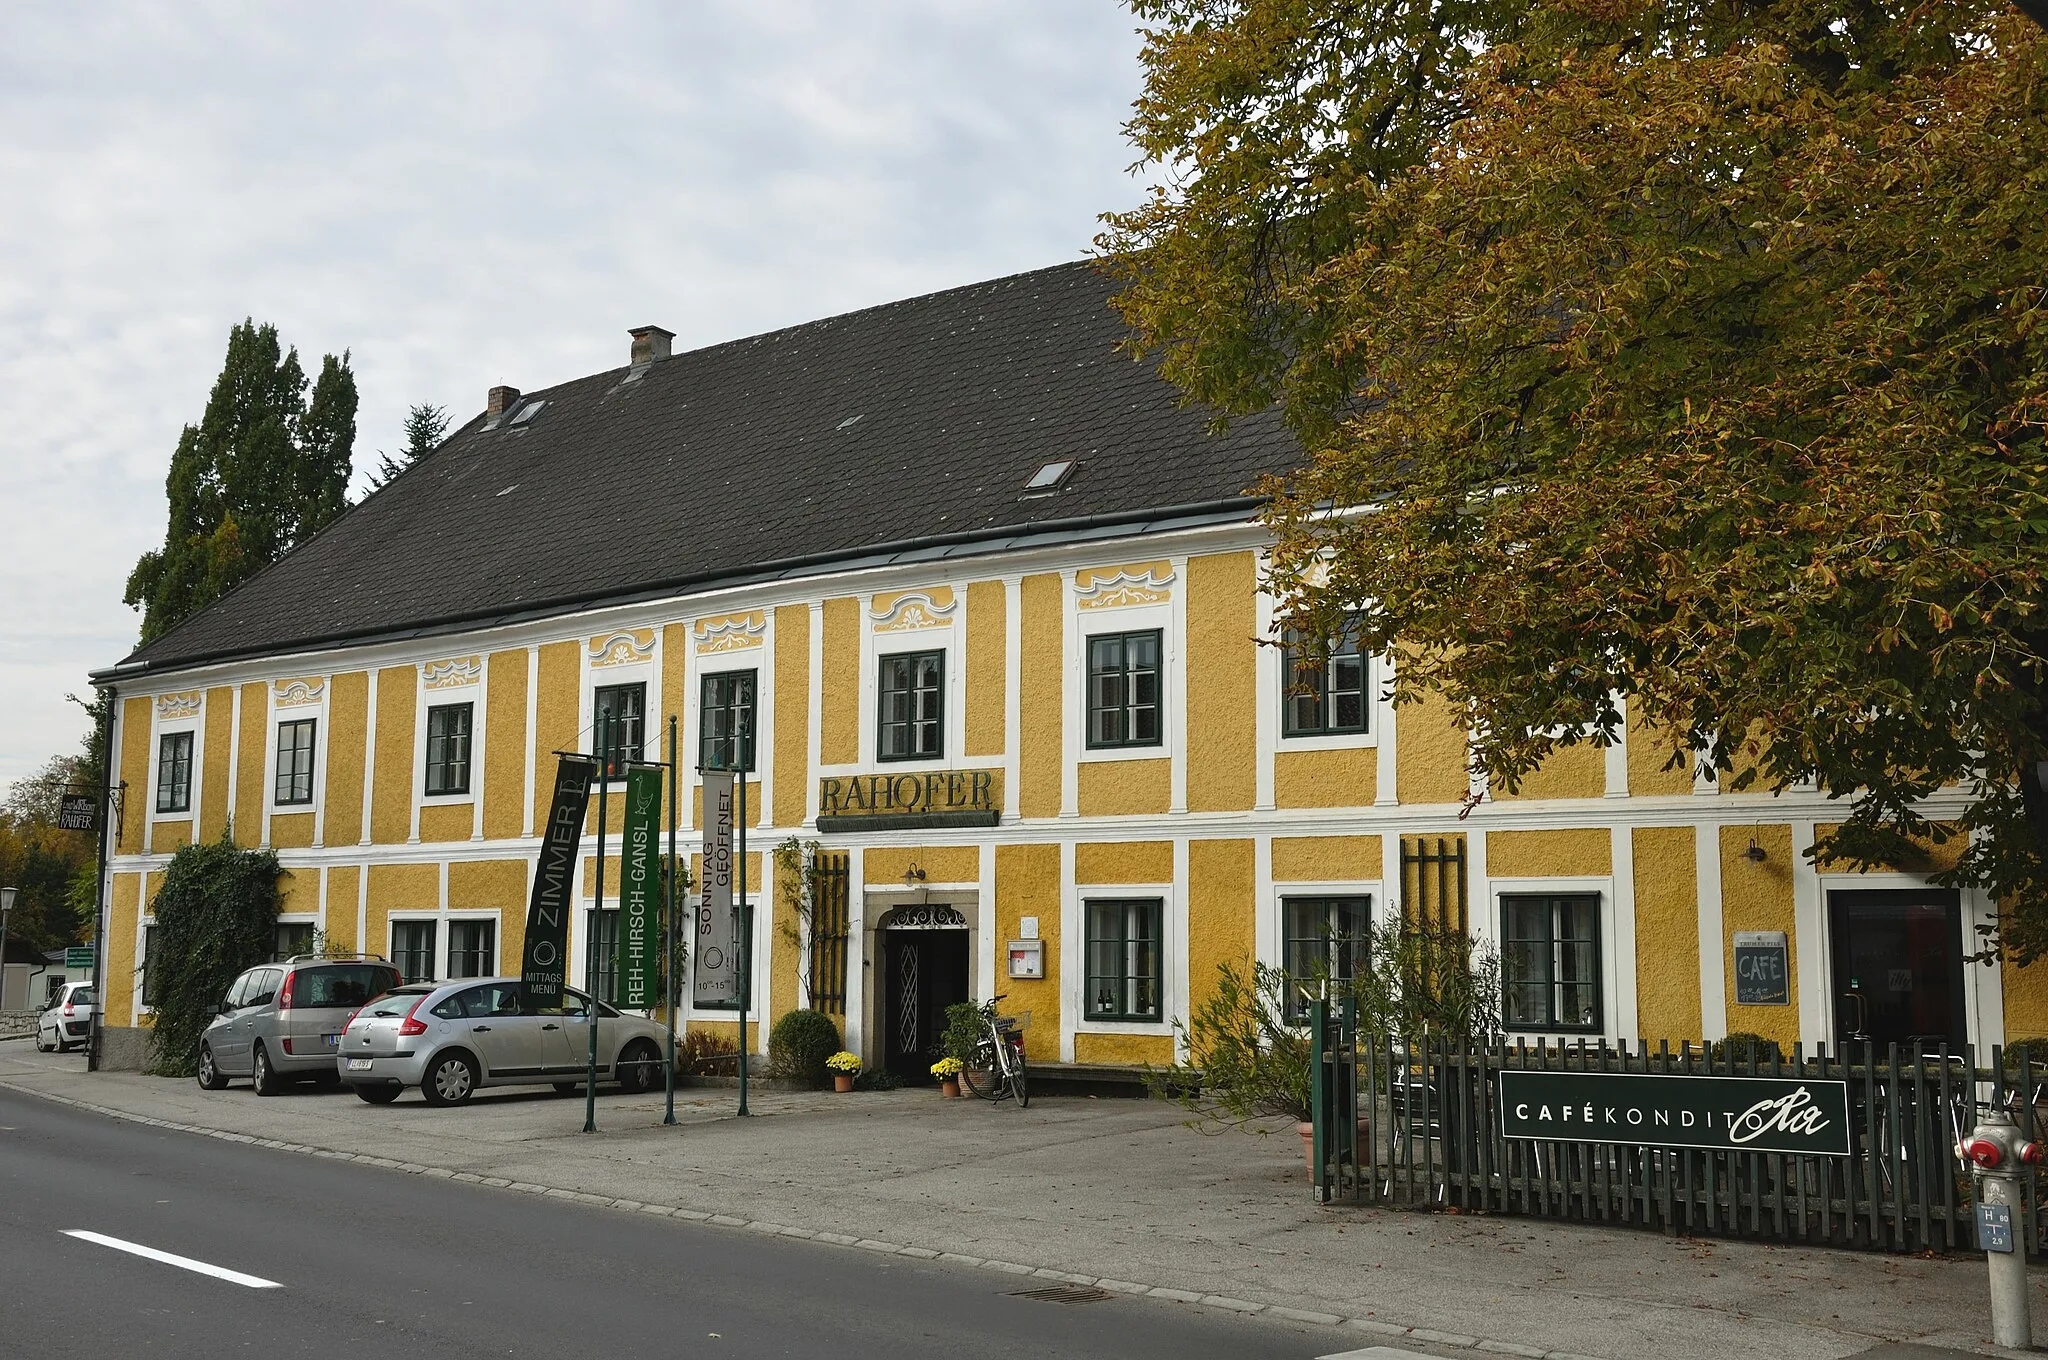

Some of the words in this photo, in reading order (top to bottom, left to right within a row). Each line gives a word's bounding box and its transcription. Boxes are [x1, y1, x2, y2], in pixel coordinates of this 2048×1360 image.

[820, 771, 992, 811] RAHOFER
[715, 790, 729, 887] GEÖFFNET
[537, 805, 577, 928] ZIMMER
[700, 842, 713, 935] SONNTAG
[628, 820, 649, 1005] REH-HIRSCH-GANSL
[525, 972, 562, 983] MITTAGS
[1739, 949, 1782, 980] CAFÉ
[531, 983, 556, 995] MENÜ
[1984, 1210, 1993, 1220] H
[1992, 1237, 2003, 1245] 2.9
